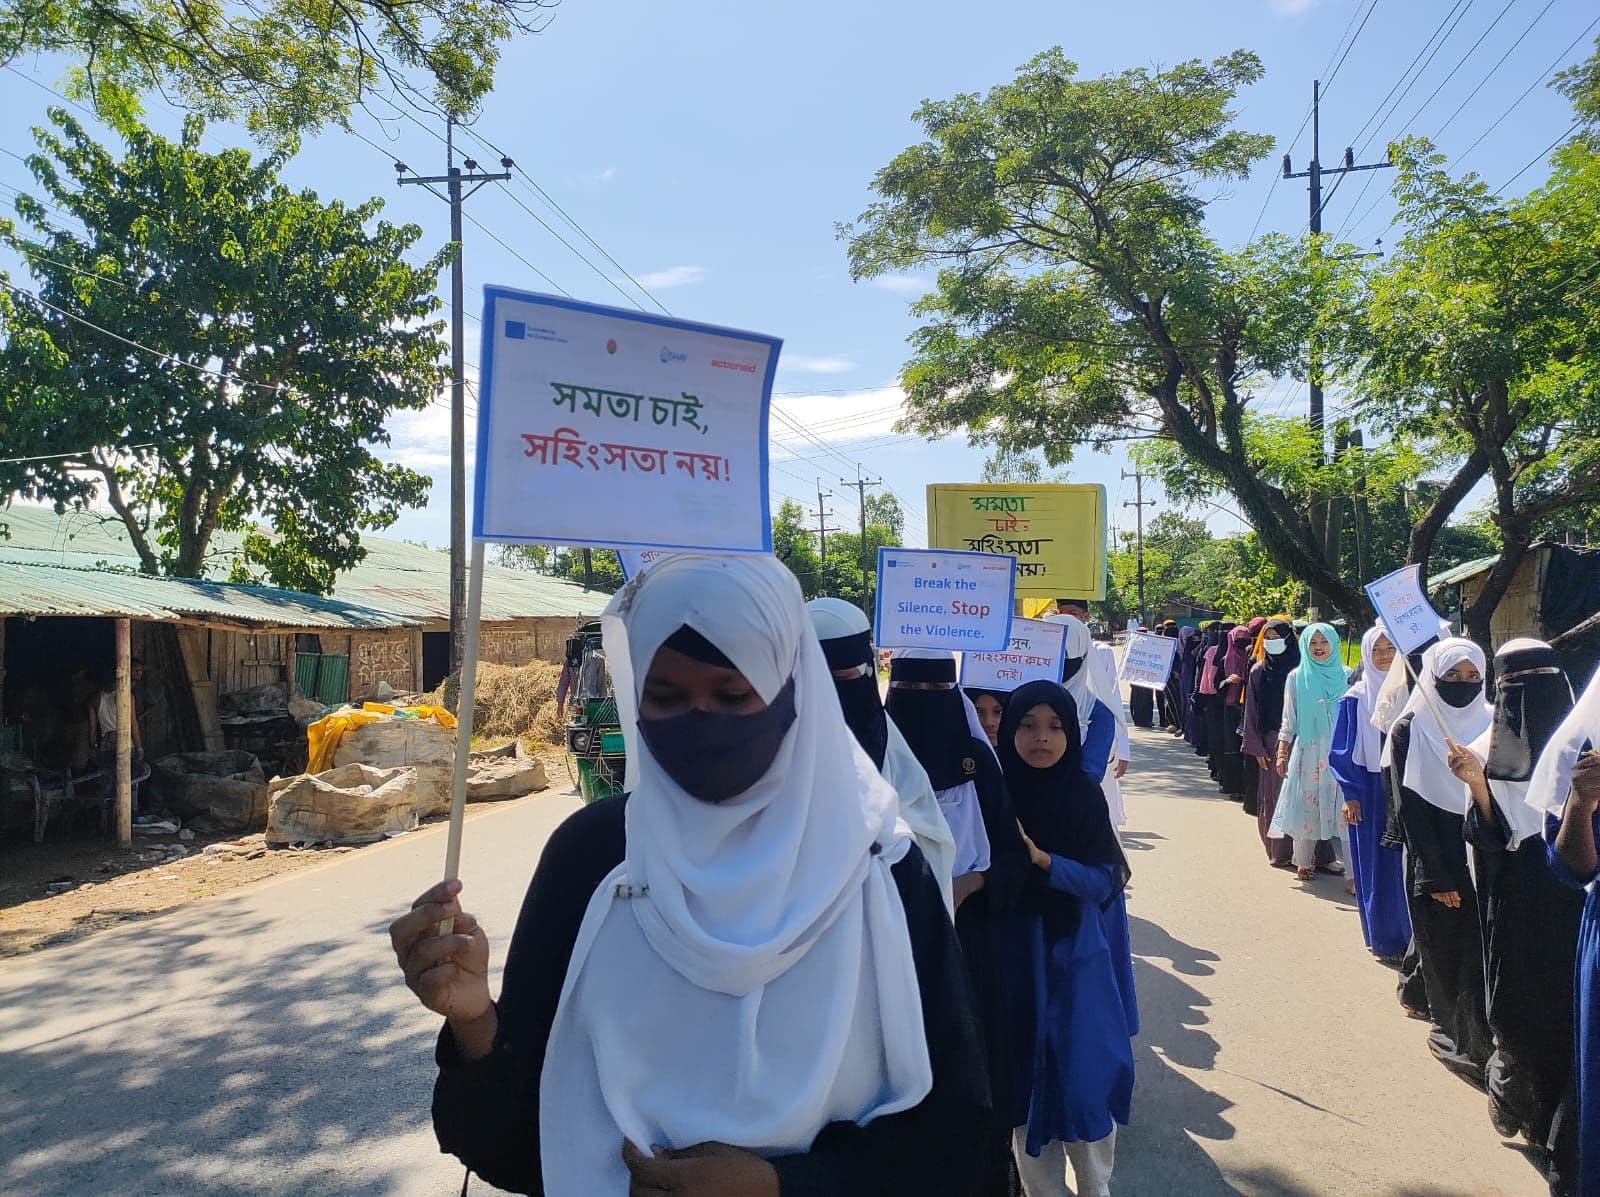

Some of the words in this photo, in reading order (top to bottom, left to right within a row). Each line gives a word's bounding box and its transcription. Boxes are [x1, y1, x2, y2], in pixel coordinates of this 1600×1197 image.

[550, 382, 643, 422] সমতা
[650, 392, 709, 435] চাই,
[521, 427, 667, 475] সহিংসতা
[673, 451, 730, 481] নয়!
[969, 496, 1034, 512] সমতা
[914, 577, 951, 589] Break
[955, 578, 977, 590] the
[897, 602, 947, 614] Silence.
[951, 600, 990, 619] Stop
[900, 624, 922, 635] the
[926, 624, 985, 639] Violence.
[1008, 638, 1031, 650] সুন,
